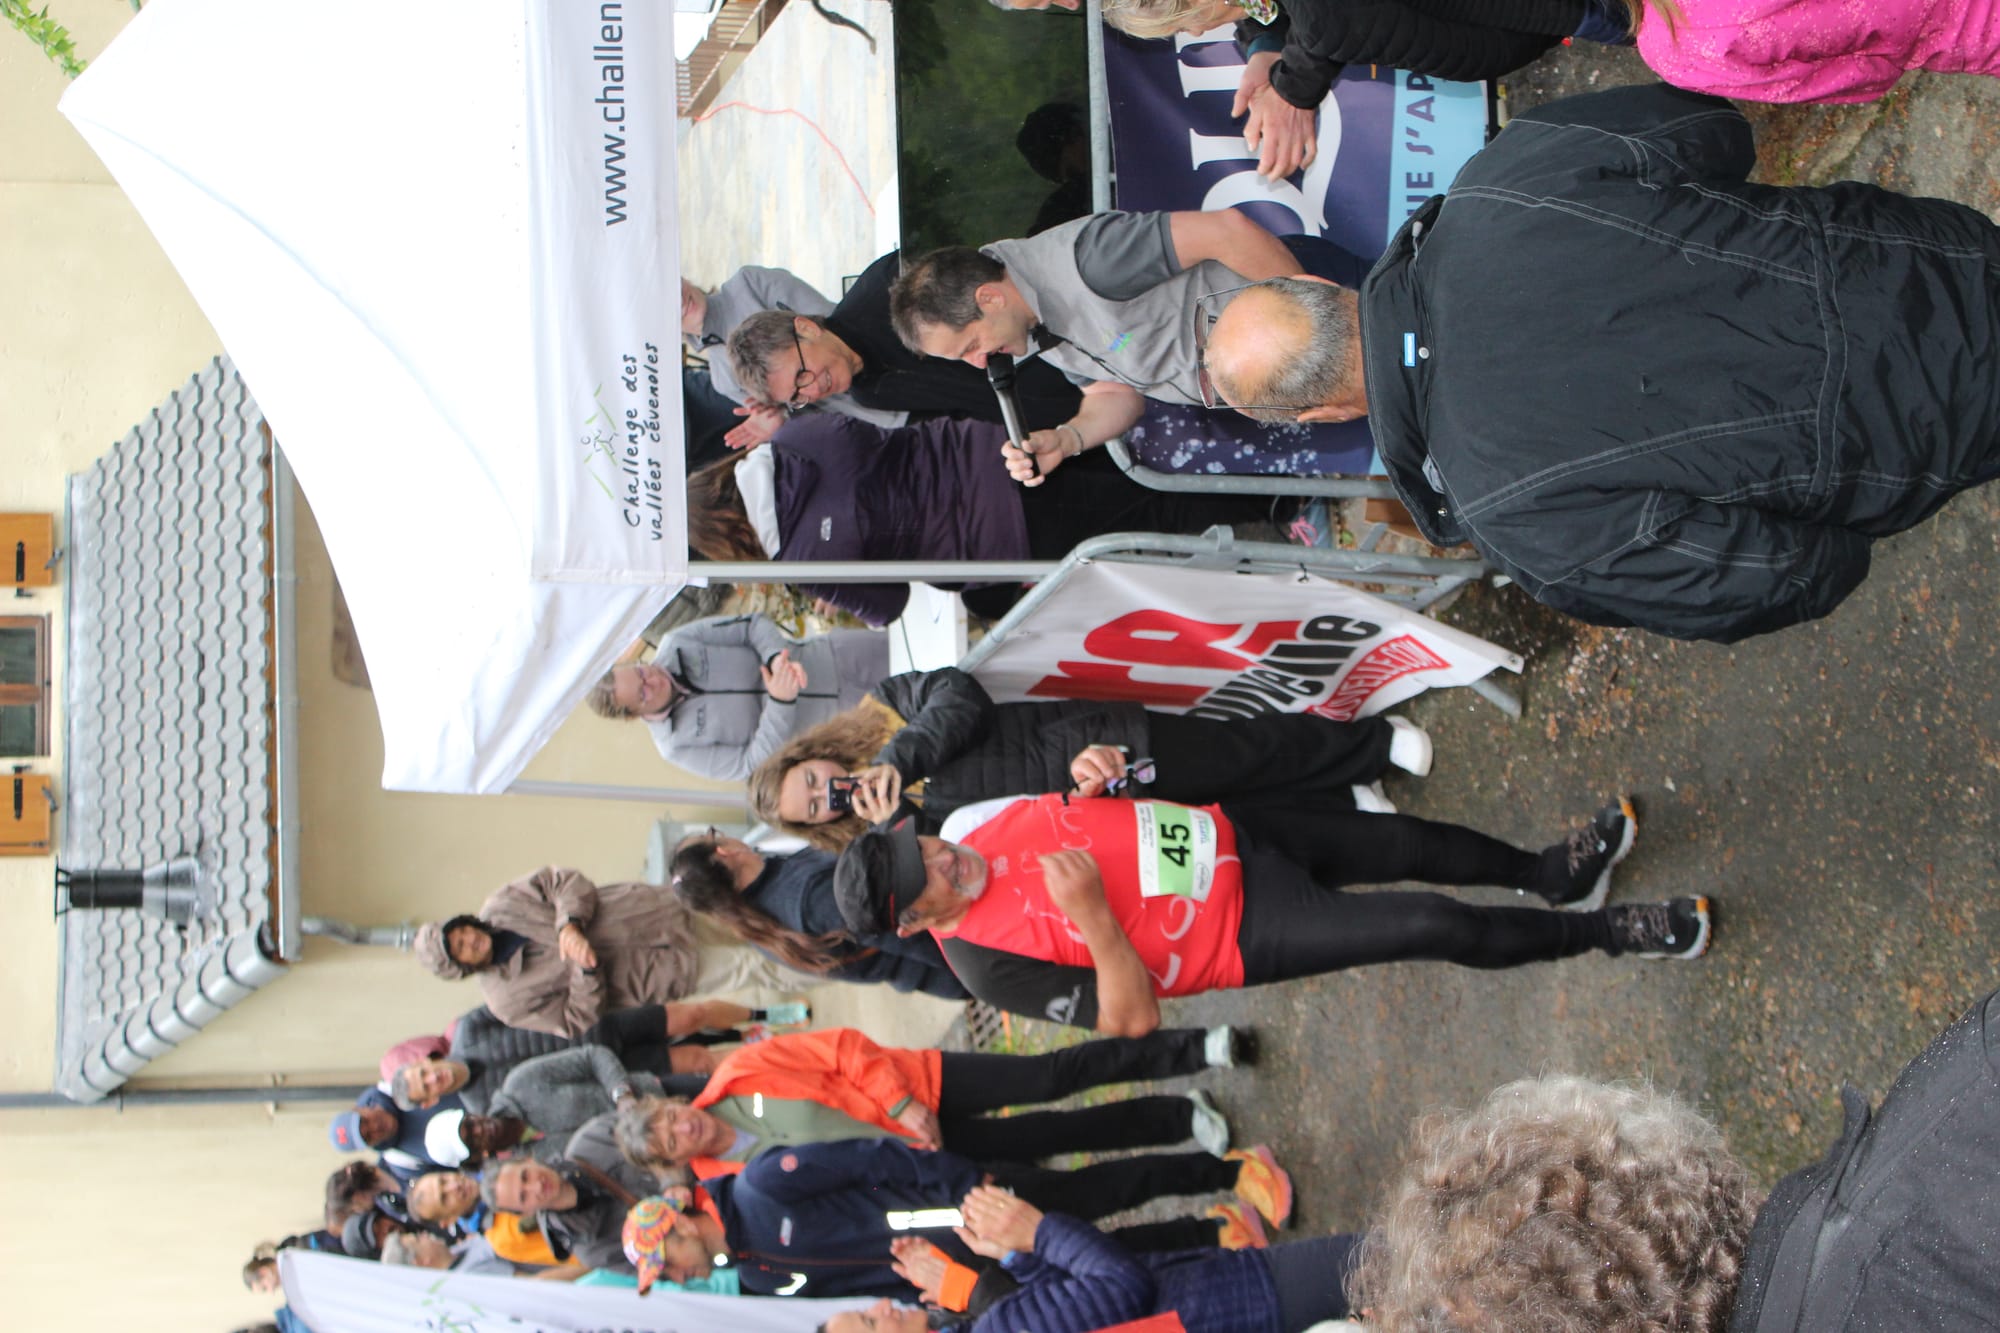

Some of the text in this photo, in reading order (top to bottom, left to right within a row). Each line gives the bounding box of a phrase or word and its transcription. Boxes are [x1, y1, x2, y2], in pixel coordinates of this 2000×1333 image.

[594, 0, 627, 226] www.challen
[1405, 71, 1435, 217] UE S'AP
[620, 353, 646, 529] Challenge des
[642, 342, 663, 542] vallées cévenoles
[1026, 608, 1302, 707] re
[1161, 823, 1191, 867] 45
